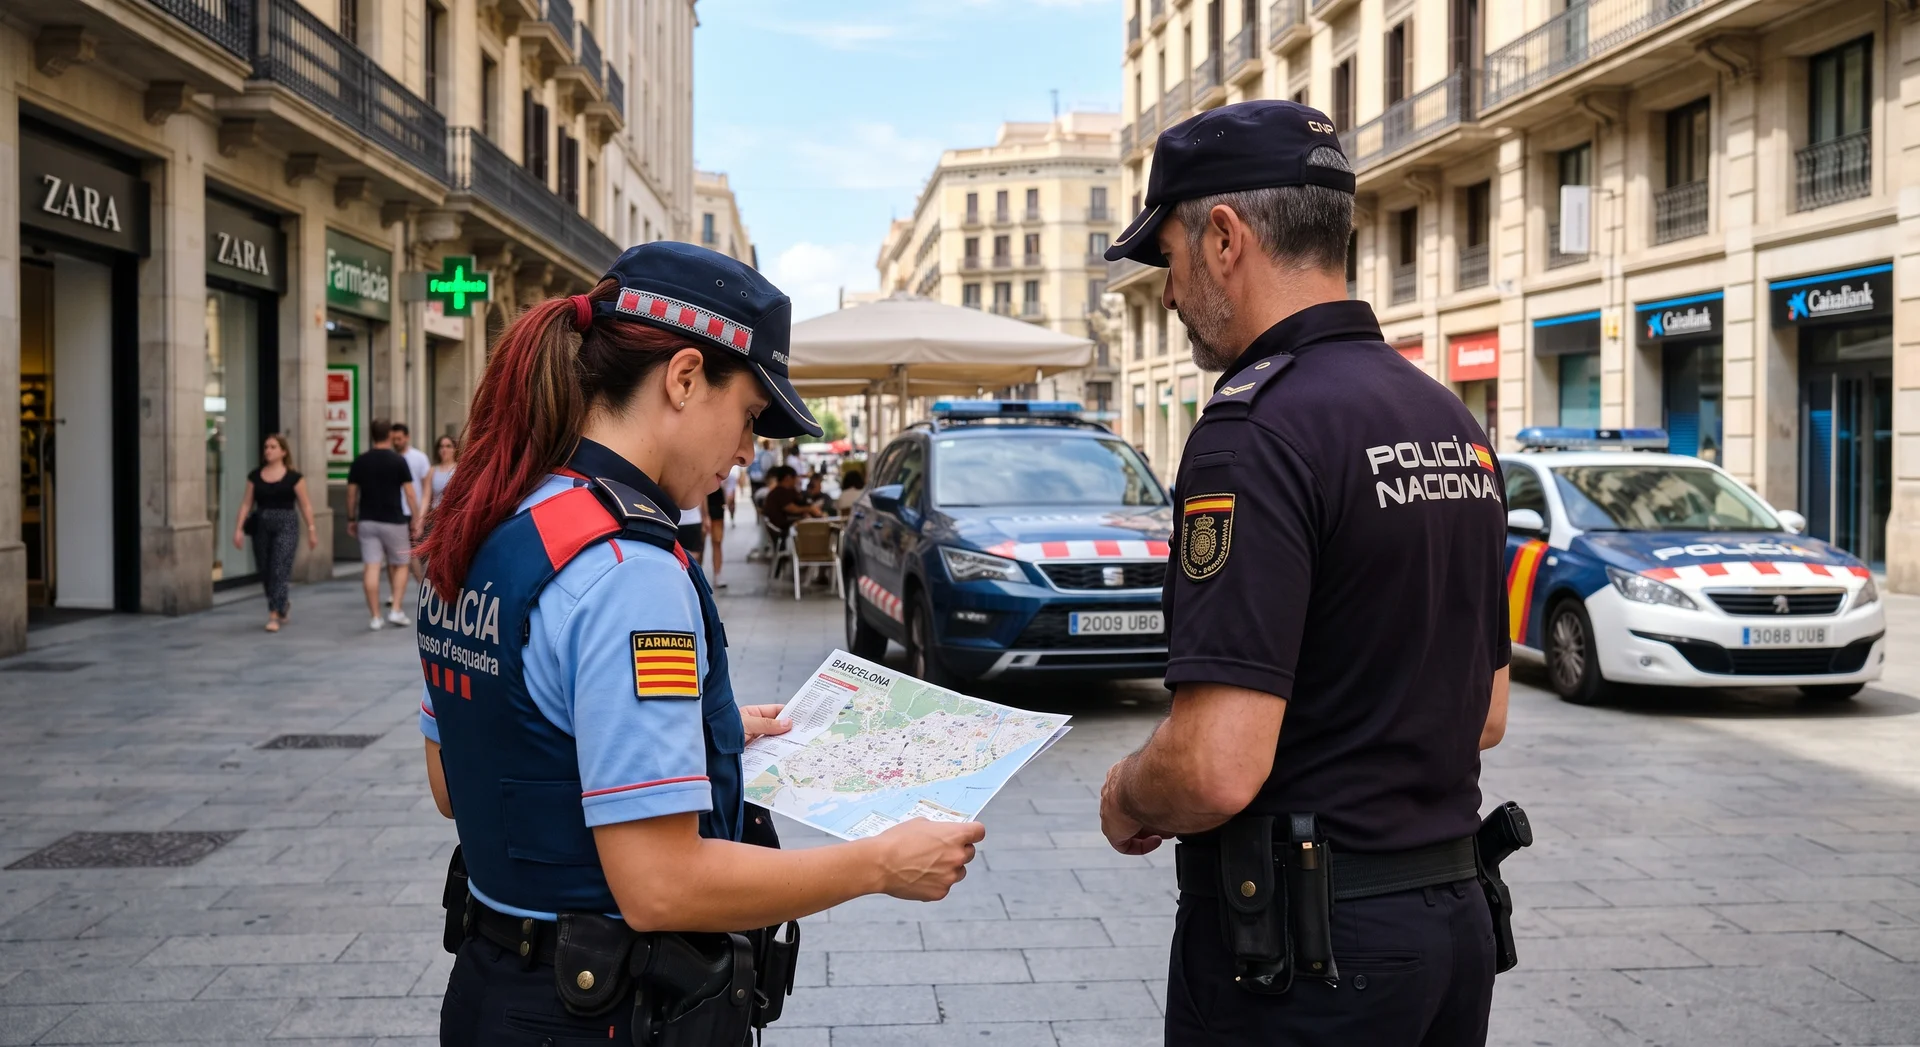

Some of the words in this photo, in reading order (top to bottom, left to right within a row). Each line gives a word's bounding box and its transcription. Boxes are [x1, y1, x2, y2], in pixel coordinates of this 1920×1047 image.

[1308, 120, 1334, 135] CNP
[43, 174, 121, 232] ZARA
[216, 232, 269, 275] ZARA
[1365, 434, 1481, 475] POLICÍA
[1375, 473, 1502, 509] NACIONAL
[418, 577, 500, 645] POLICÍA
[1081, 616, 1123, 632] 2009
[1128, 615, 1159, 631] UBG
[637, 637, 693, 648] FARMACIA
[832, 659, 891, 687] BARCELONA
